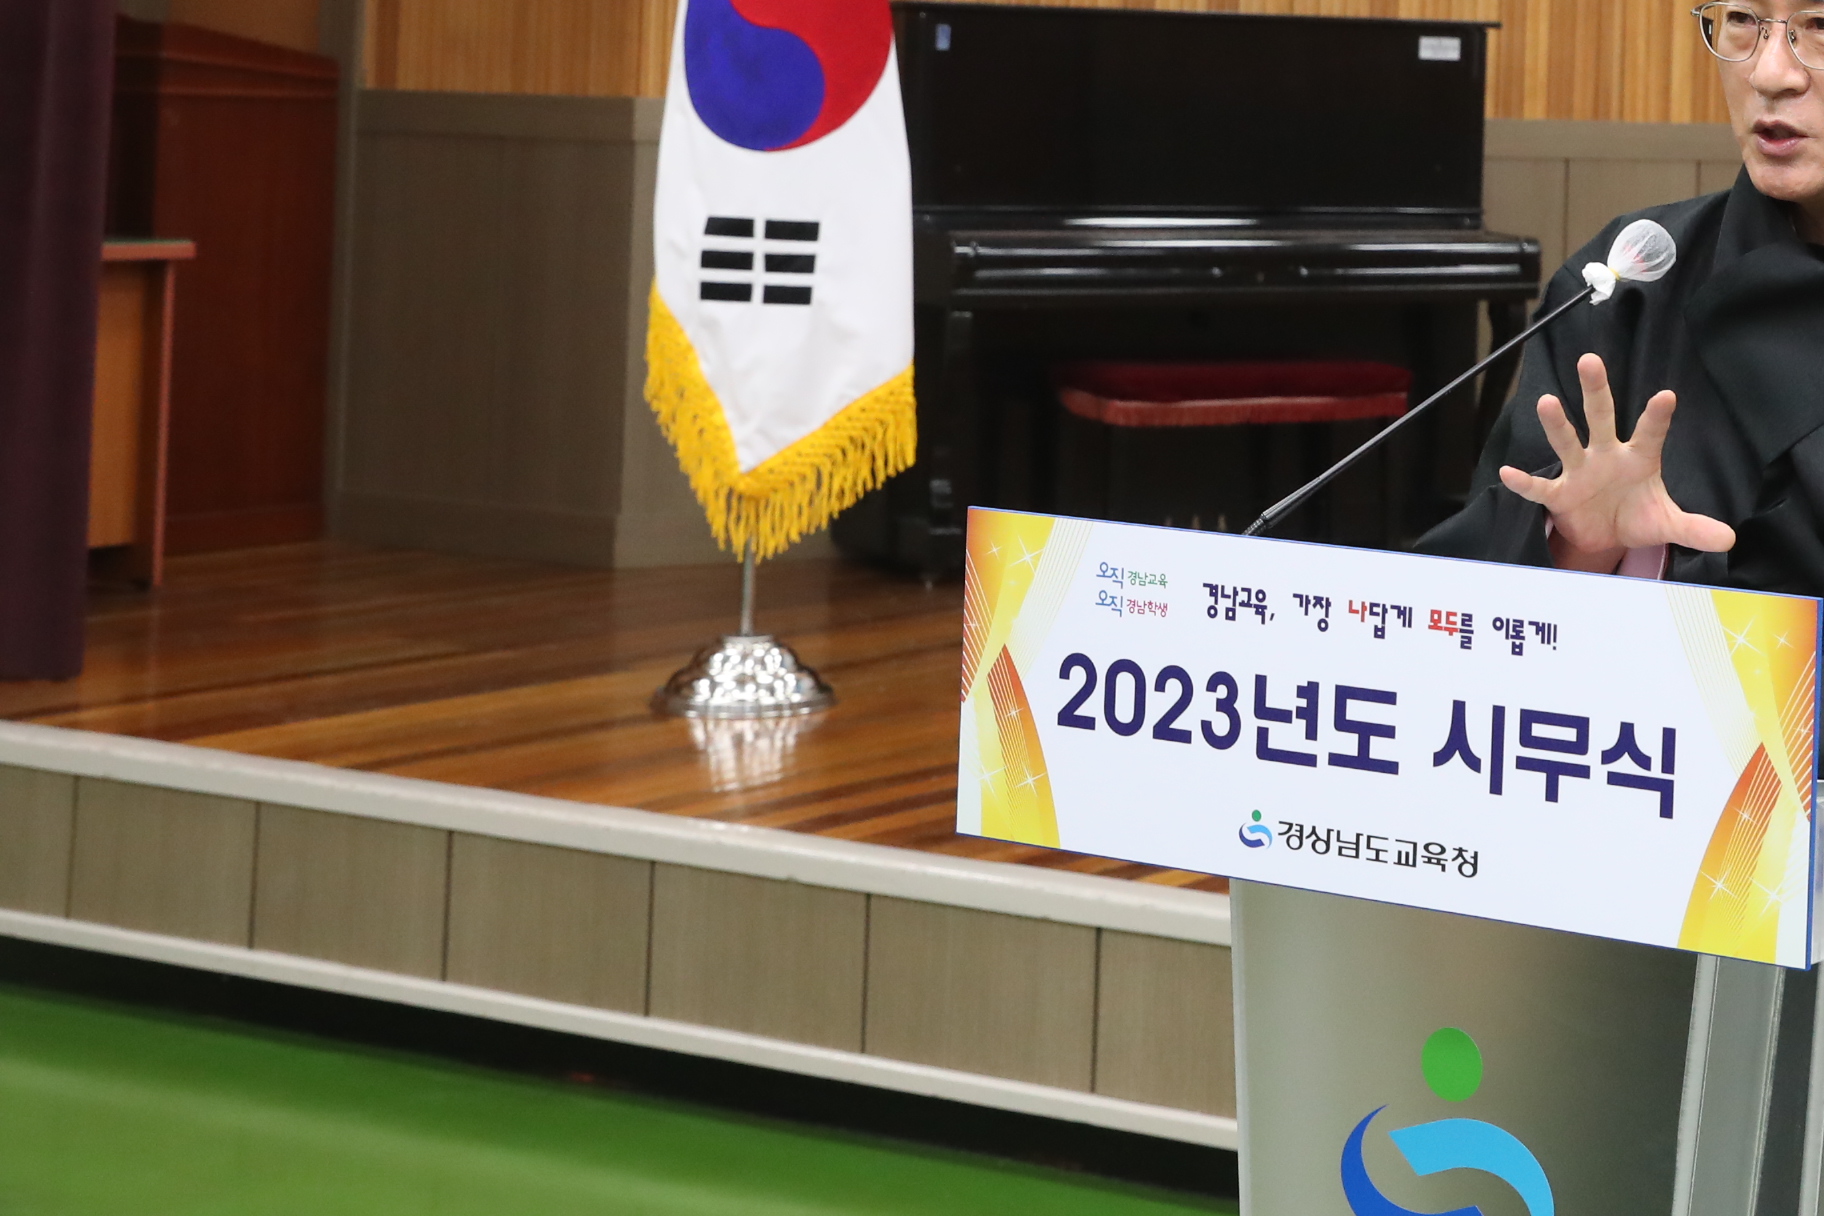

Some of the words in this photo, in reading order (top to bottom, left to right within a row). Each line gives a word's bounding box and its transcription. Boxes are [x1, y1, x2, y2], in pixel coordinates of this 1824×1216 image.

[1095, 589, 1124, 618] 오직
[1126, 598, 1169, 618] 경남학생
[1096, 561, 1125, 589] 오직
[1127, 570, 1169, 589] 경남교육
[1202, 582, 1275, 625] 경남교육,
[1292, 593, 1332, 632] 가장
[1348, 600, 1413, 639] 나답게
[1428, 608, 1474, 650] 모두를
[1492, 616, 1558, 656] 이롭게!
[1056, 651, 1400, 775] 2023년도
[1432, 698, 1677, 819] 시무식
[1278, 820, 1479, 879] 경상남도교육청
